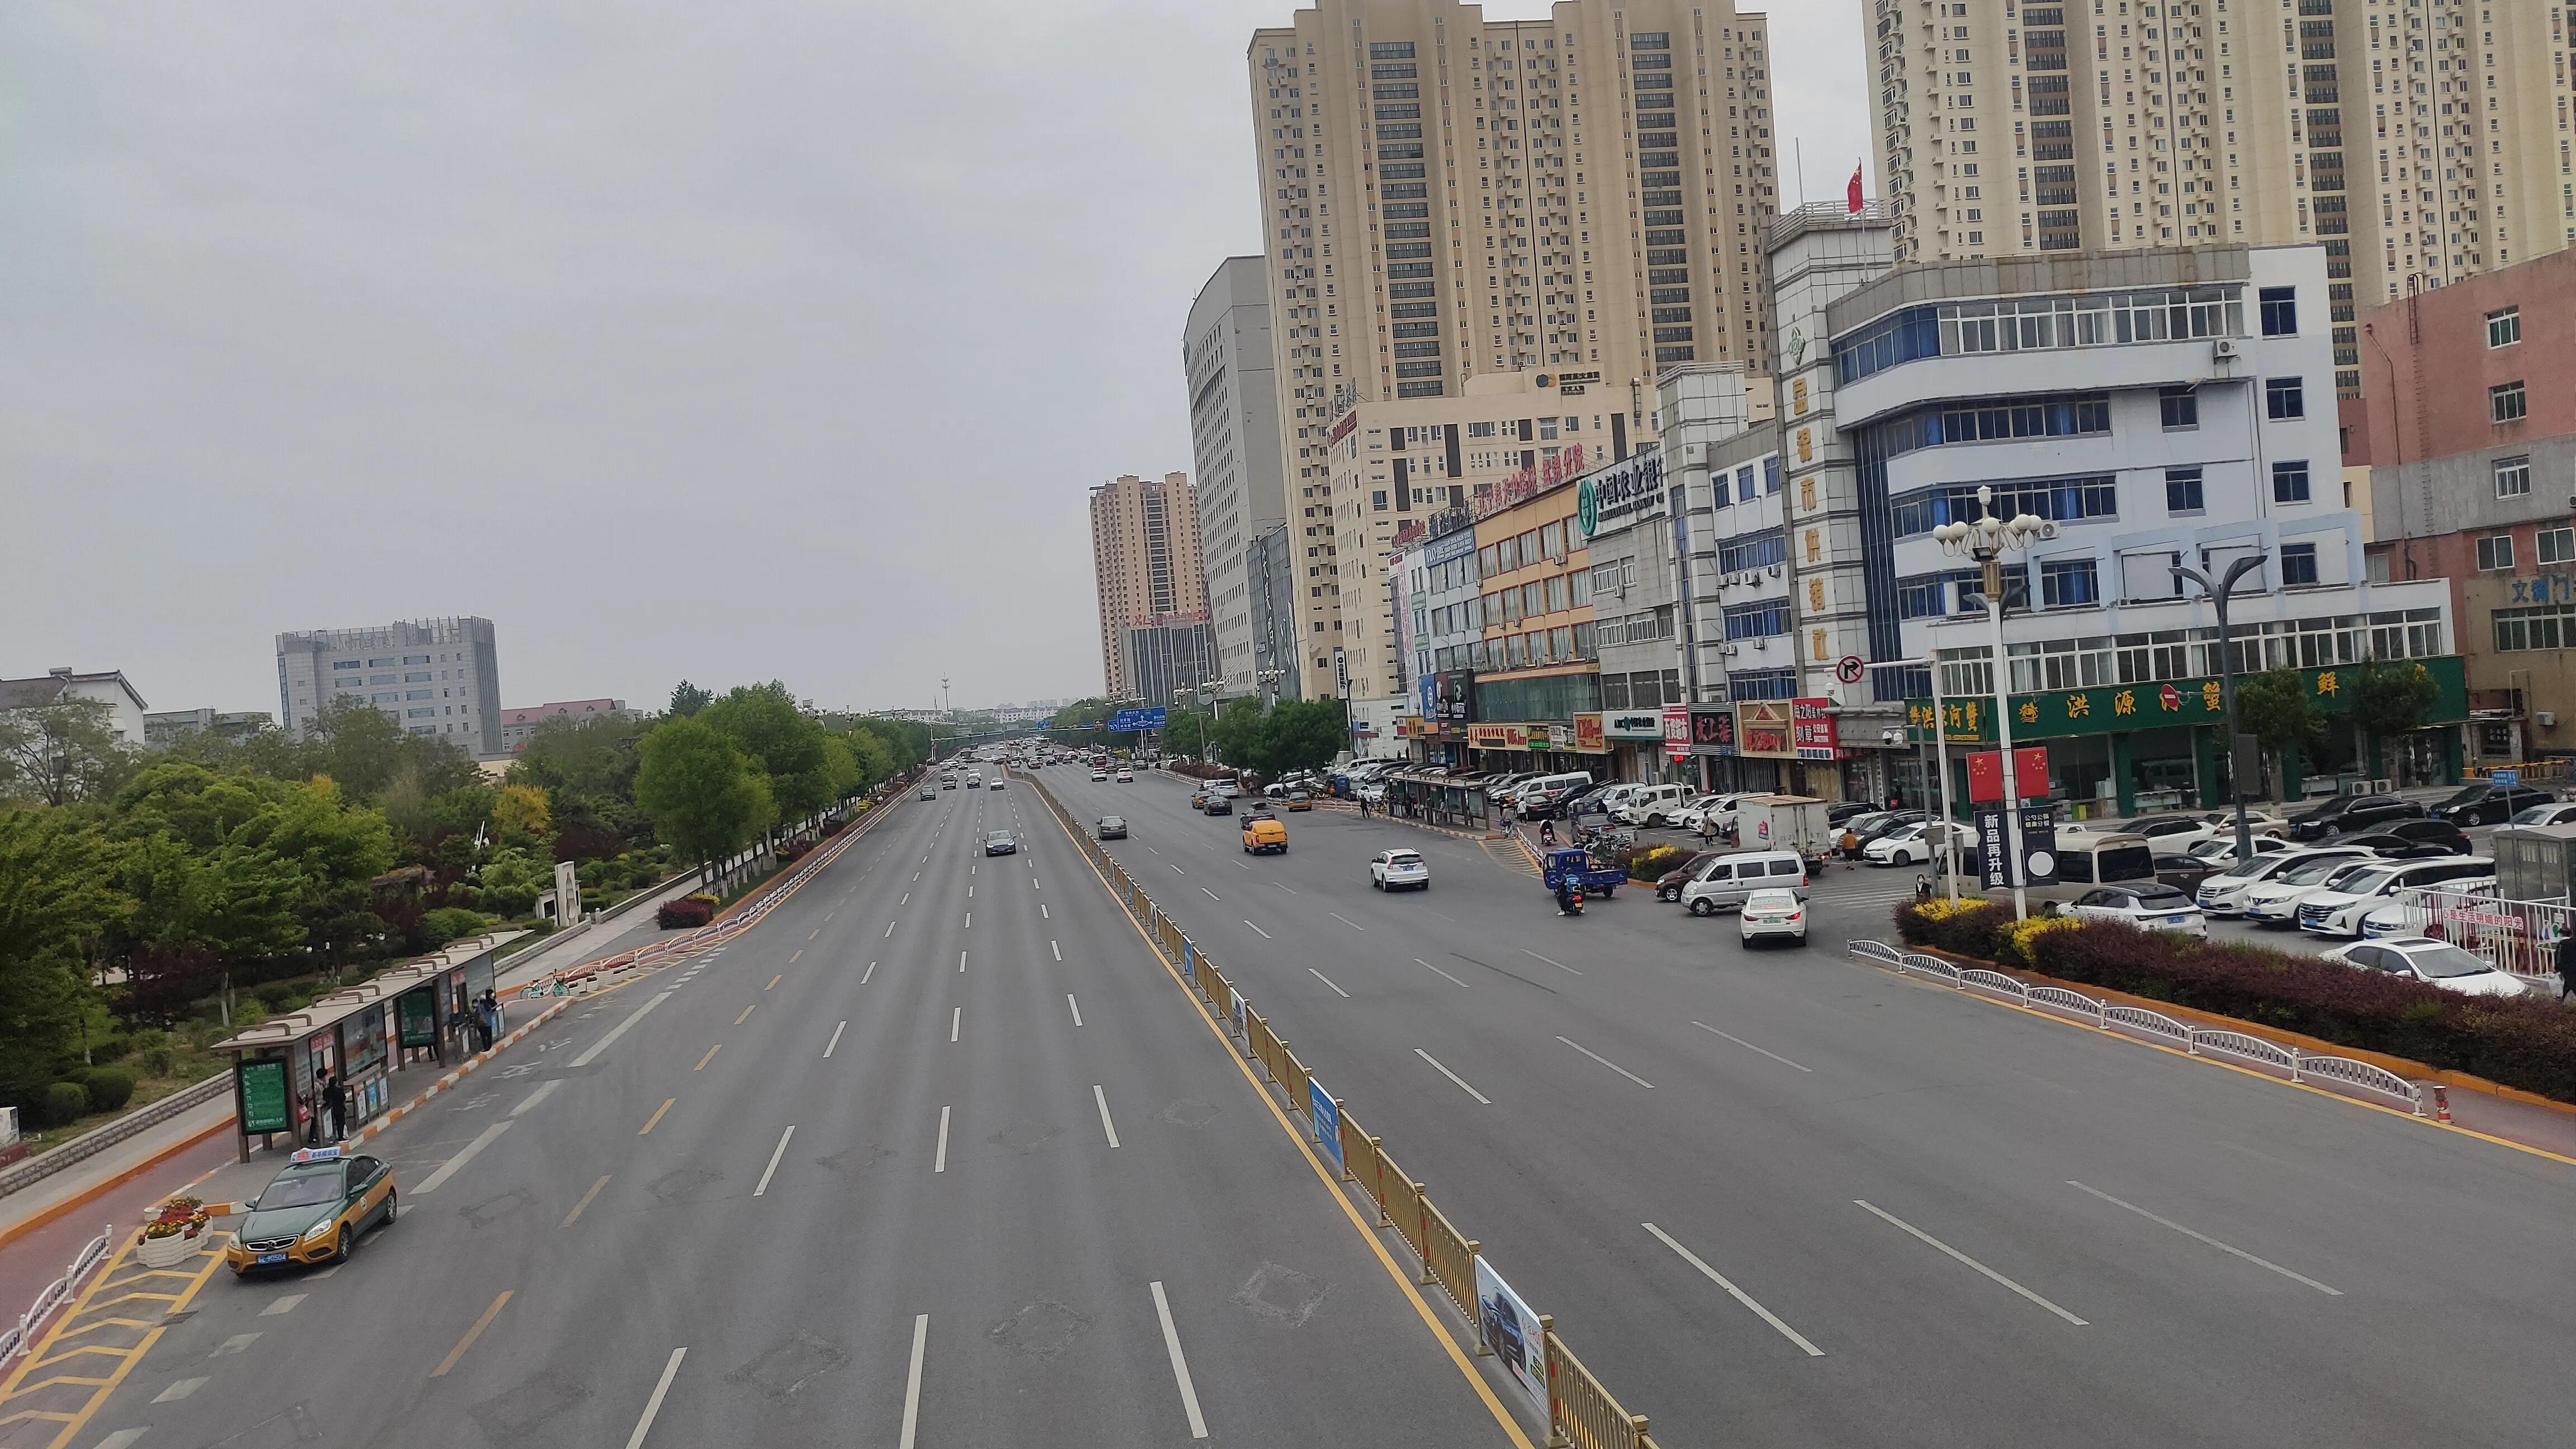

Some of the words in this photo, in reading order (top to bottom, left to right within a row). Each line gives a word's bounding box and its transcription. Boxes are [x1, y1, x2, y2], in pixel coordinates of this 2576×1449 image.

[1792, 377, 1830, 661] 盘锦市供销社
[1984, 814, 2005, 886] 新品再升级
